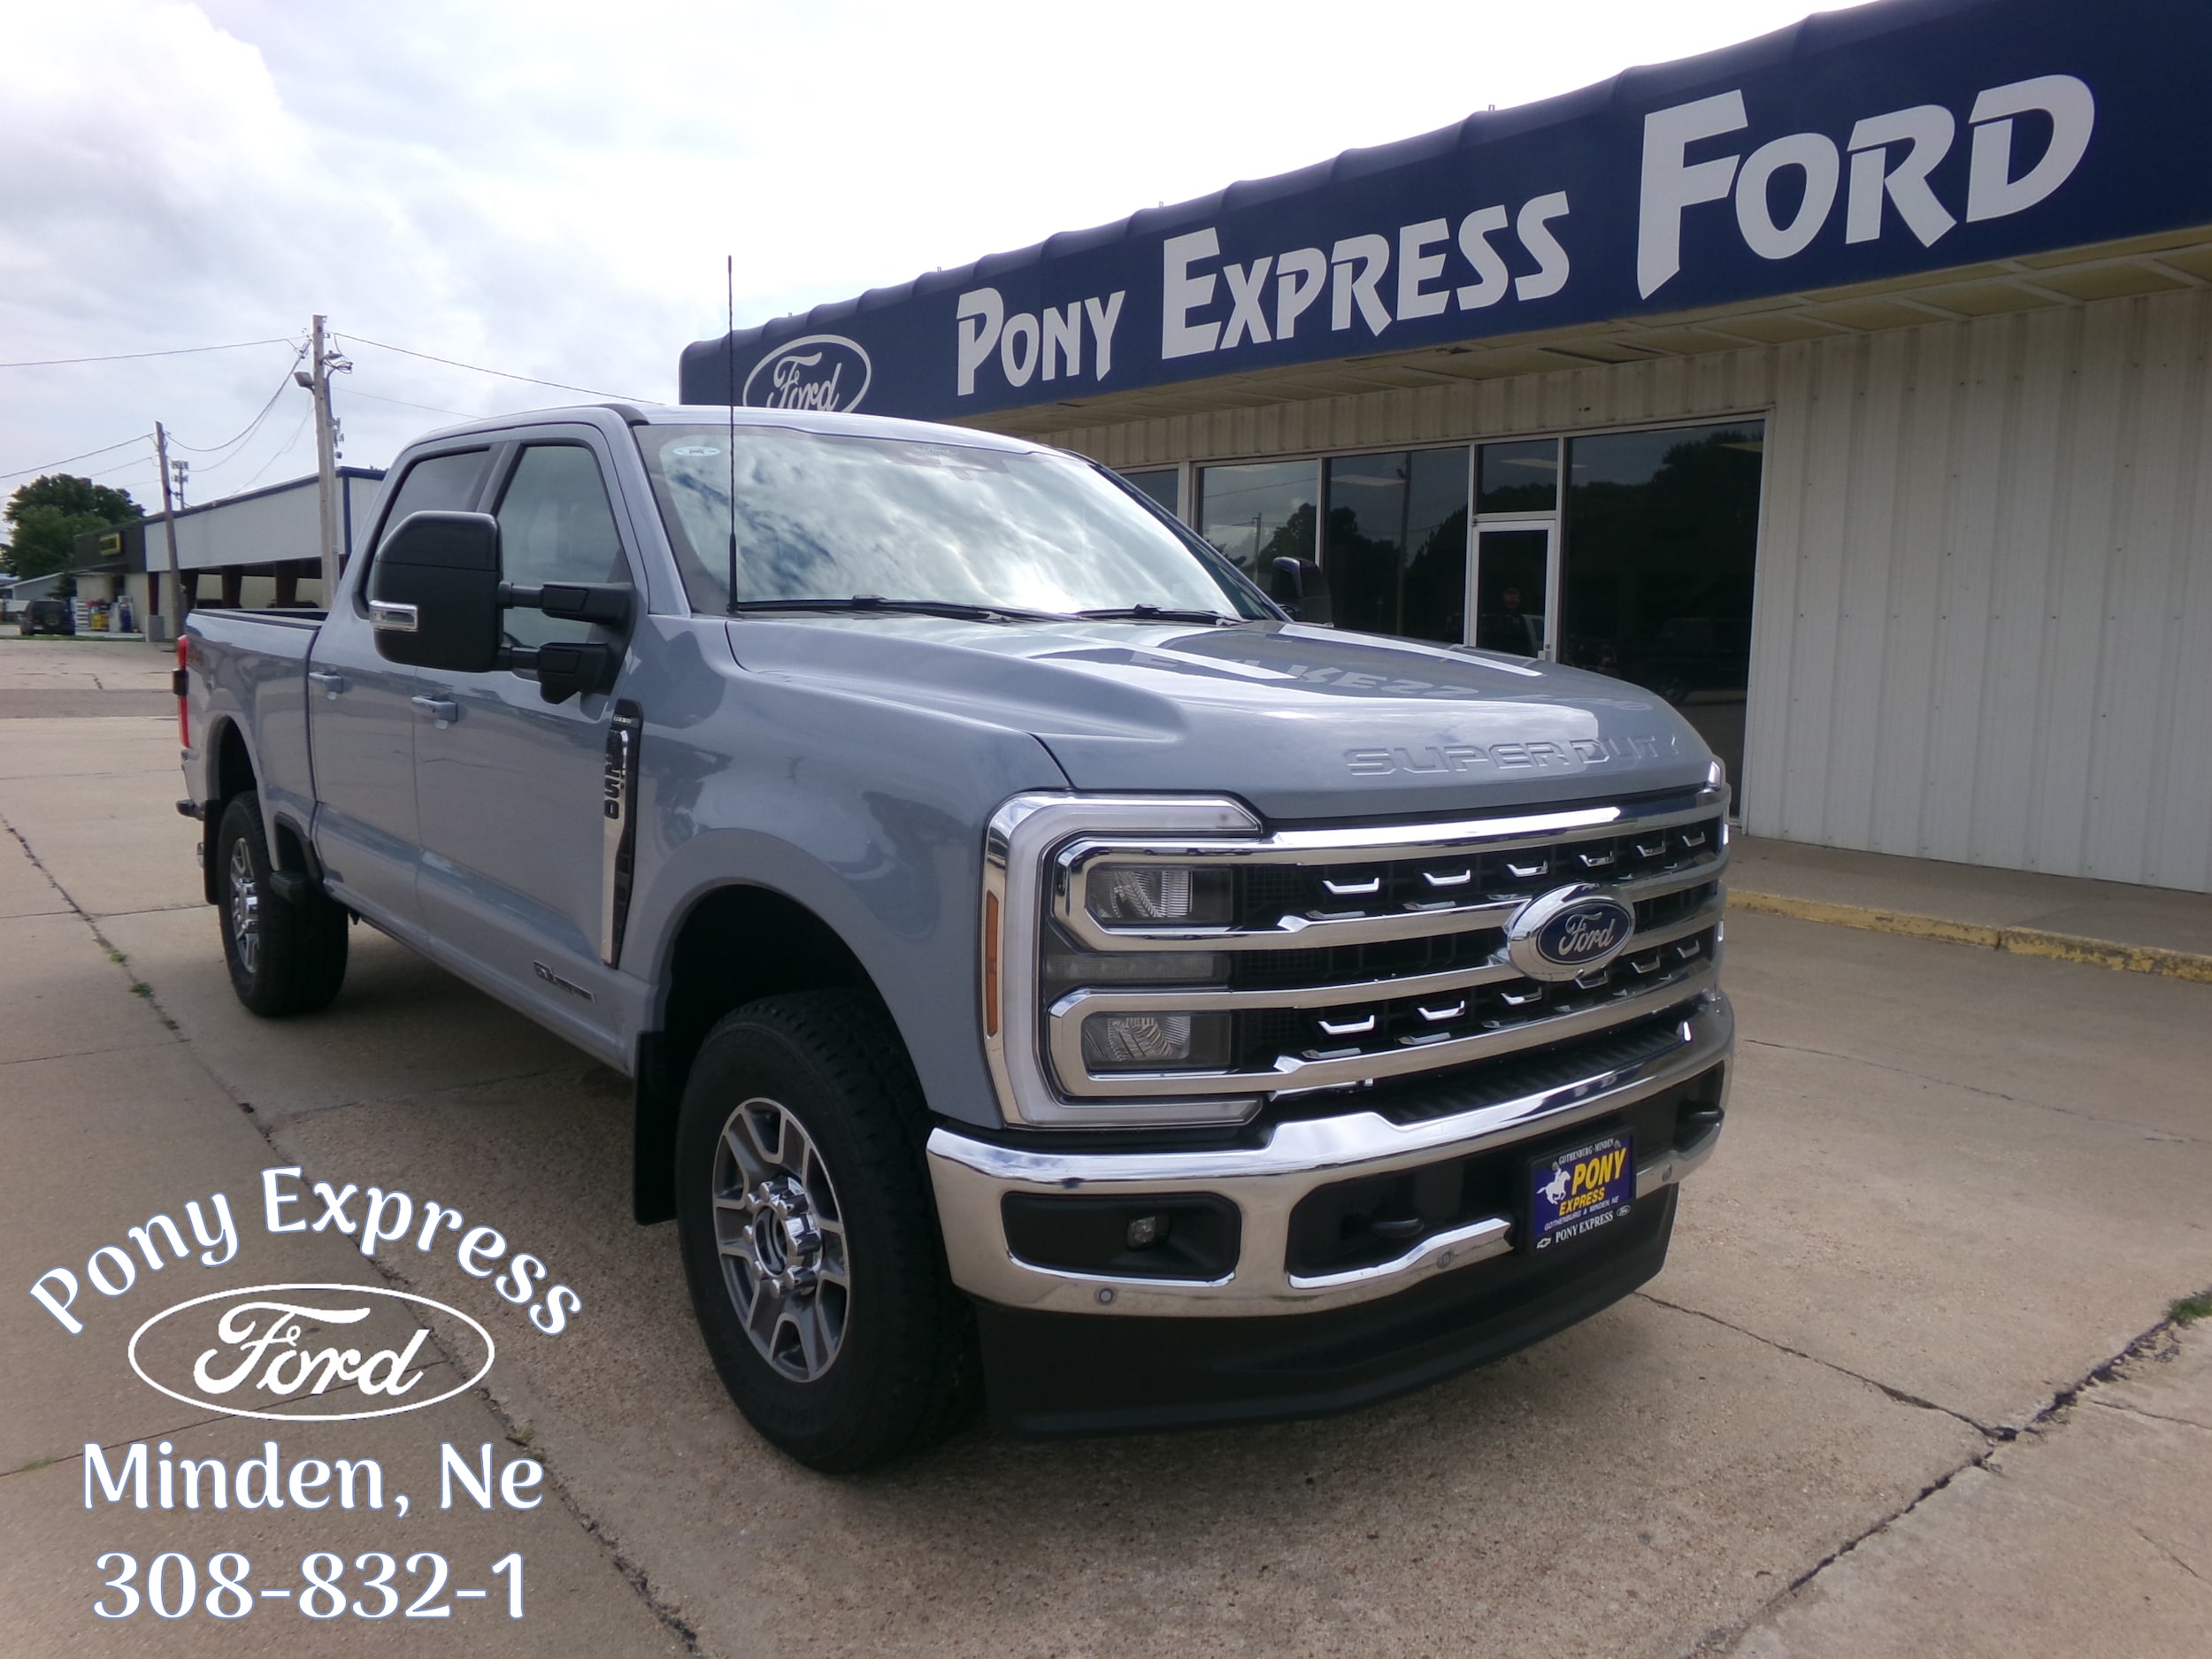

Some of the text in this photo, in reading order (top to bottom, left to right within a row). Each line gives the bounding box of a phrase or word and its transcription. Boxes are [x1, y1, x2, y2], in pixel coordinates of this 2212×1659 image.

[956, 73, 2095, 396] PONY EXPRESS FORD
[766, 351, 843, 411] Ford
[1343, 741, 1570, 777] SUPER
[1558, 911, 1616, 956] Ford
[1571, 1147, 1627, 1195] PONY
[1559, 1187, 1606, 1217] EXPRESS
[1555, 1223, 1579, 1244] PONY
[1578, 1210, 1614, 1234] EXPRESS
